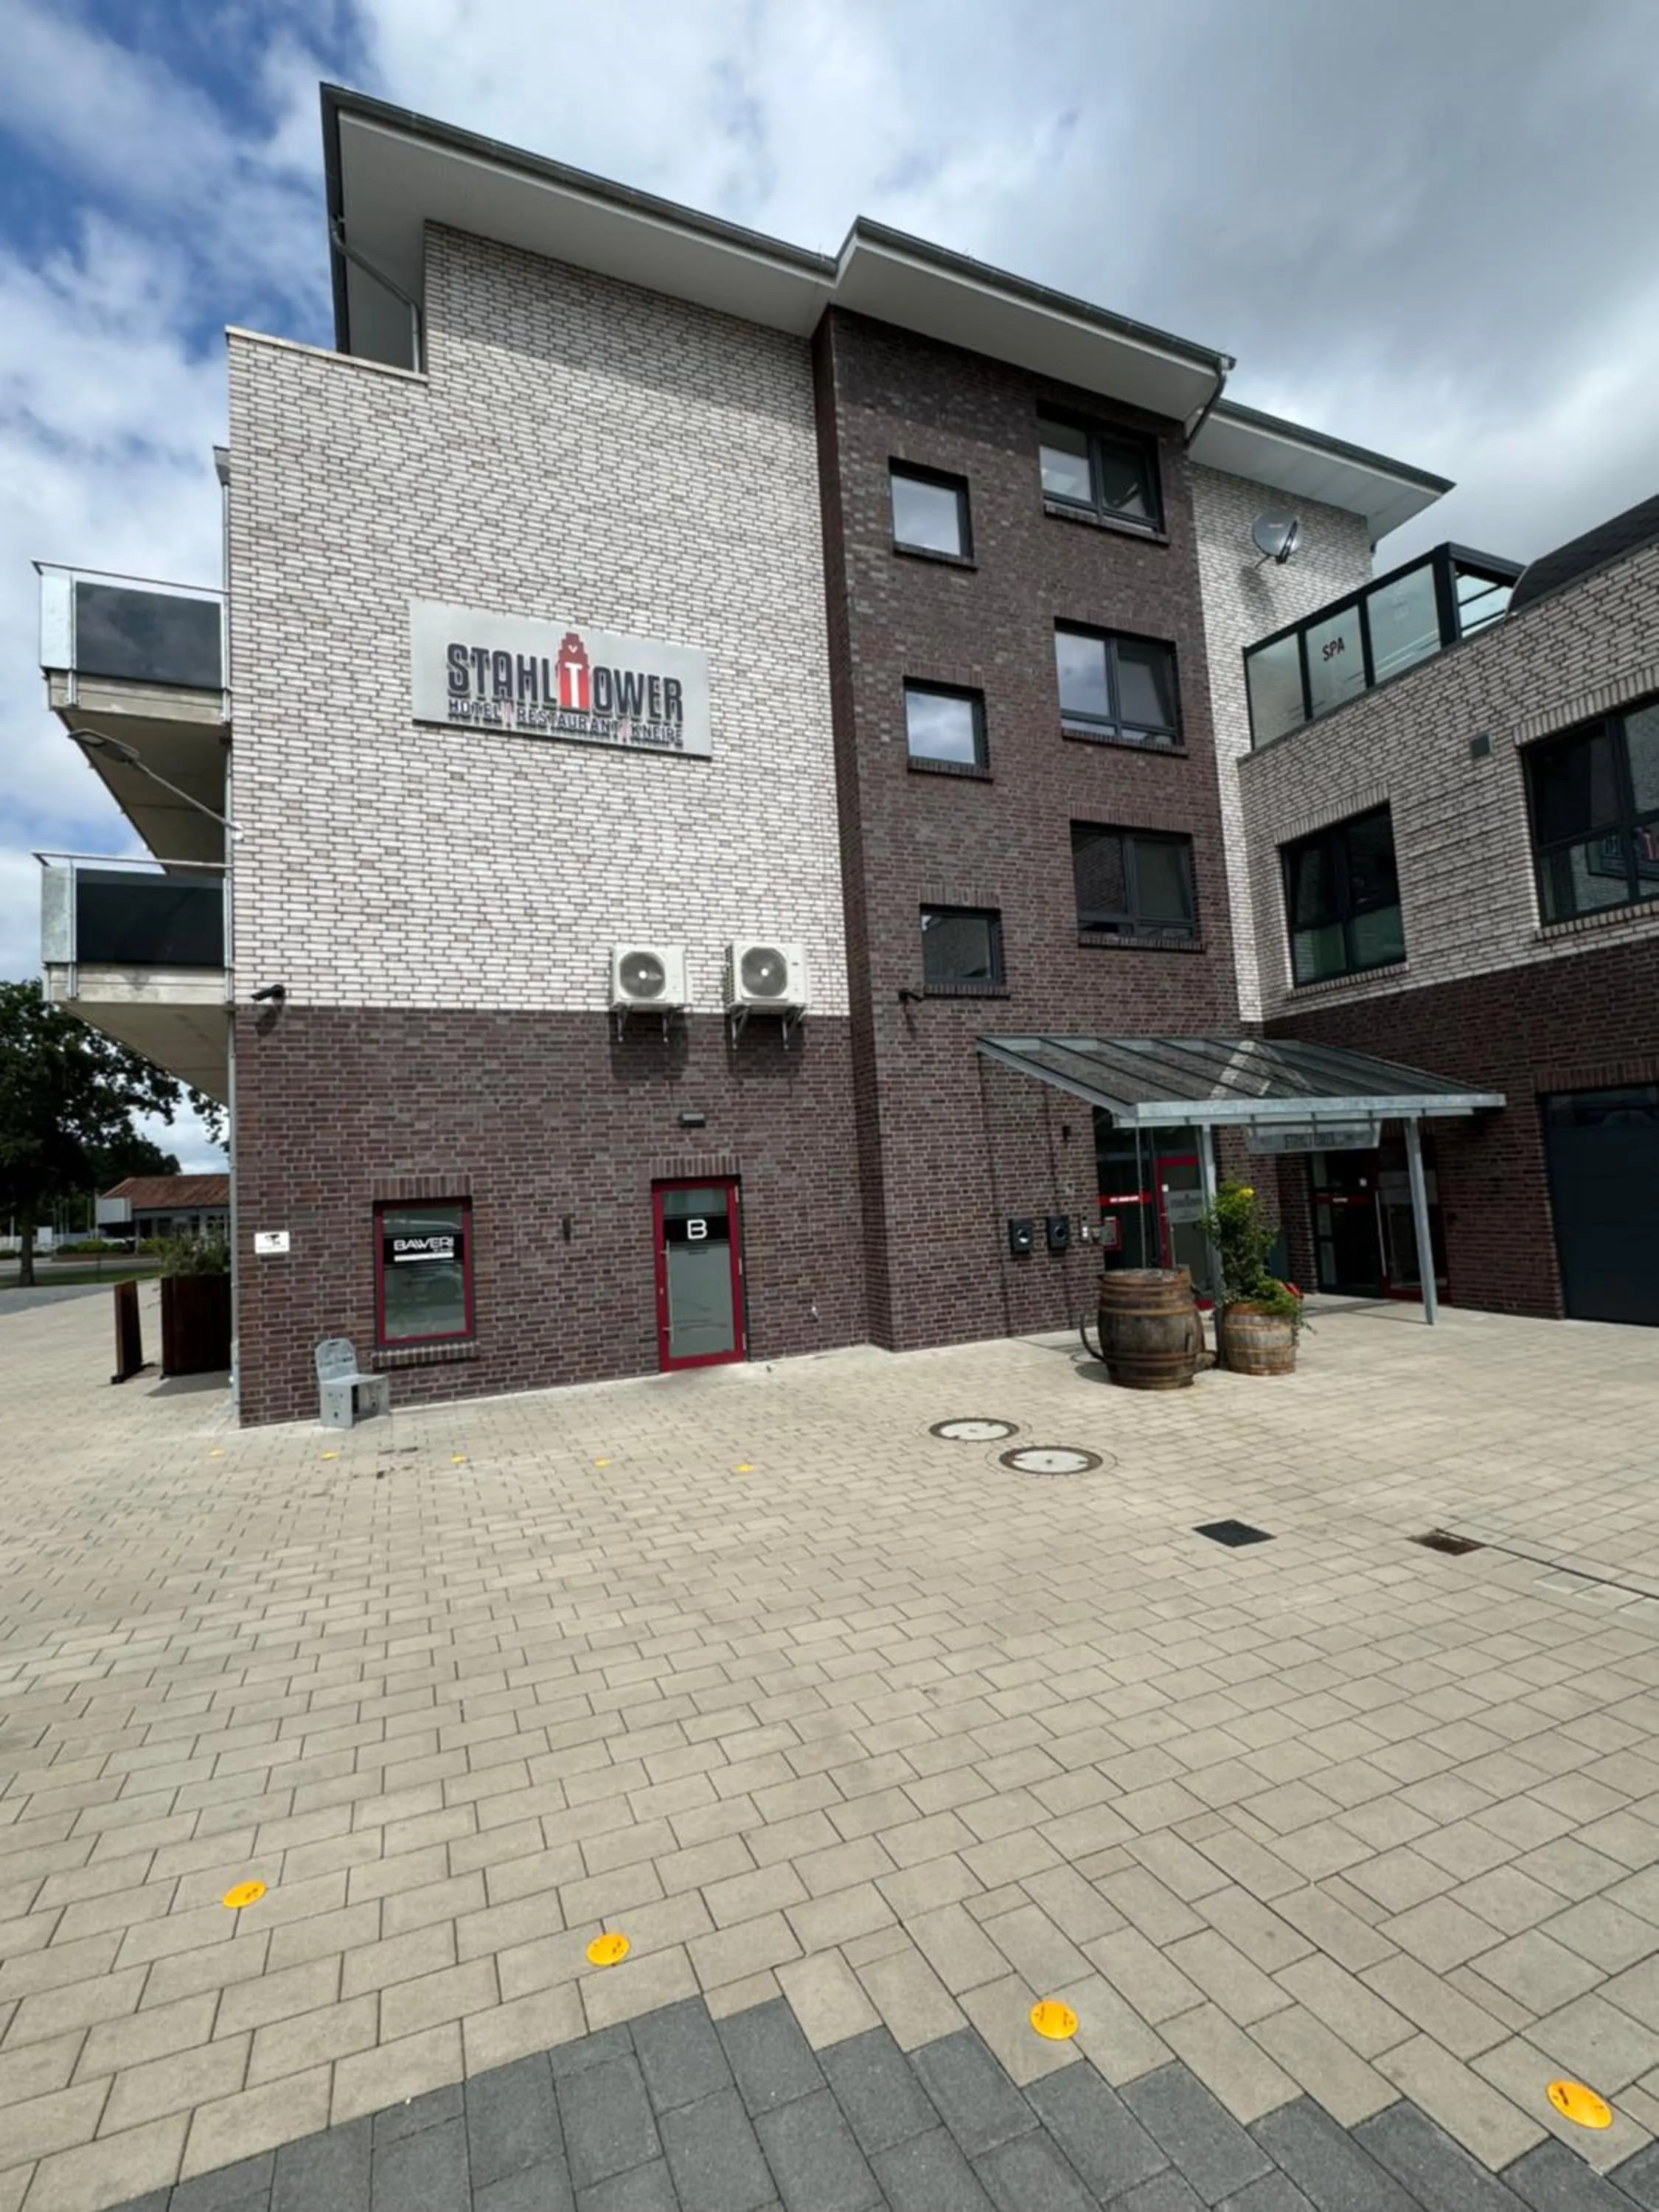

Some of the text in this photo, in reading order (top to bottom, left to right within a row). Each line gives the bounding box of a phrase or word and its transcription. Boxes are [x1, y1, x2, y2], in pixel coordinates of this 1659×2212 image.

[1322, 637, 1345, 662] SPA
[448, 698, 502, 719] HOTEL
[517, 707, 619, 734] RESTAURANT
[686, 1219, 708, 1239] B
